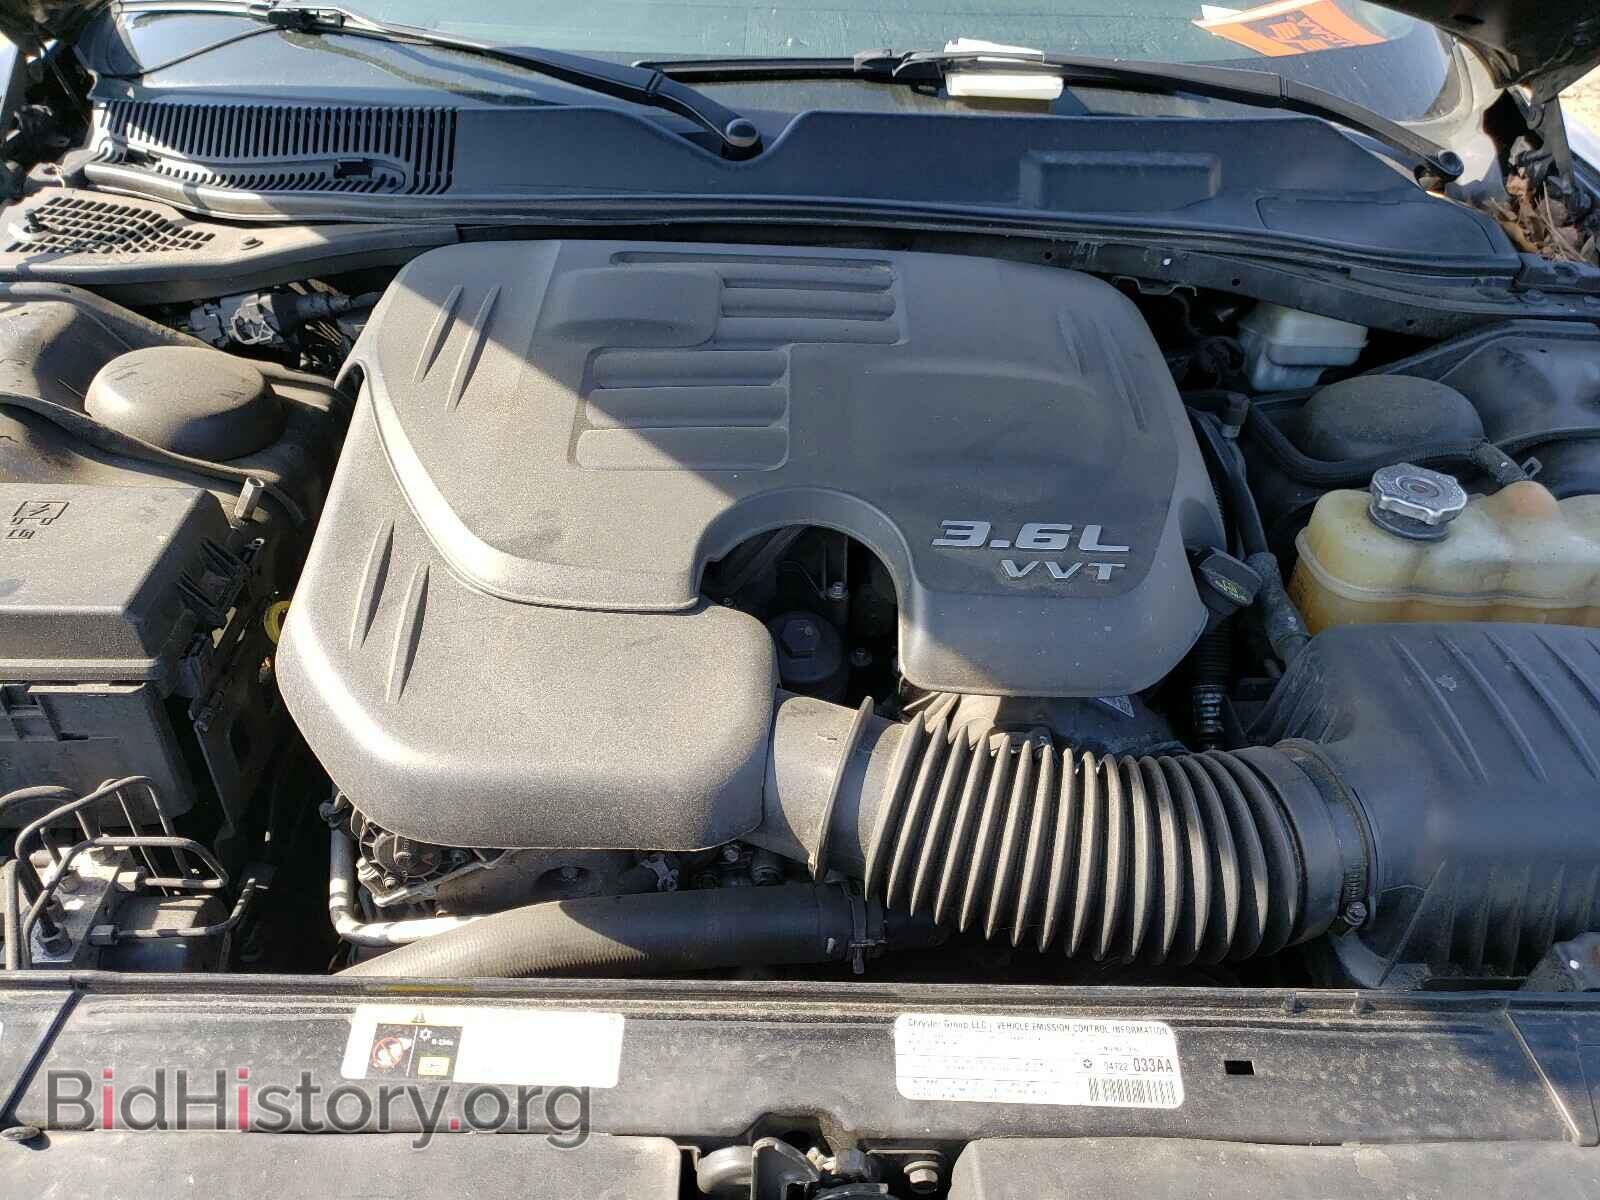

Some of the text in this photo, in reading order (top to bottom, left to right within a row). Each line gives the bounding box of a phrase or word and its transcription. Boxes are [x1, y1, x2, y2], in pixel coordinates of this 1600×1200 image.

[932, 519, 1130, 551] 3.6L
[1001, 559, 1126, 580] VVT
[997, 1021, 1029, 1031] VEHICLE
[1032, 1023, 1070, 1033] EMISSION
[1073, 1024, 1111, 1034] CONTROL
[1112, 1025, 1168, 1035] INFORMATION
[1133, 1058, 1174, 1073] 033AA
